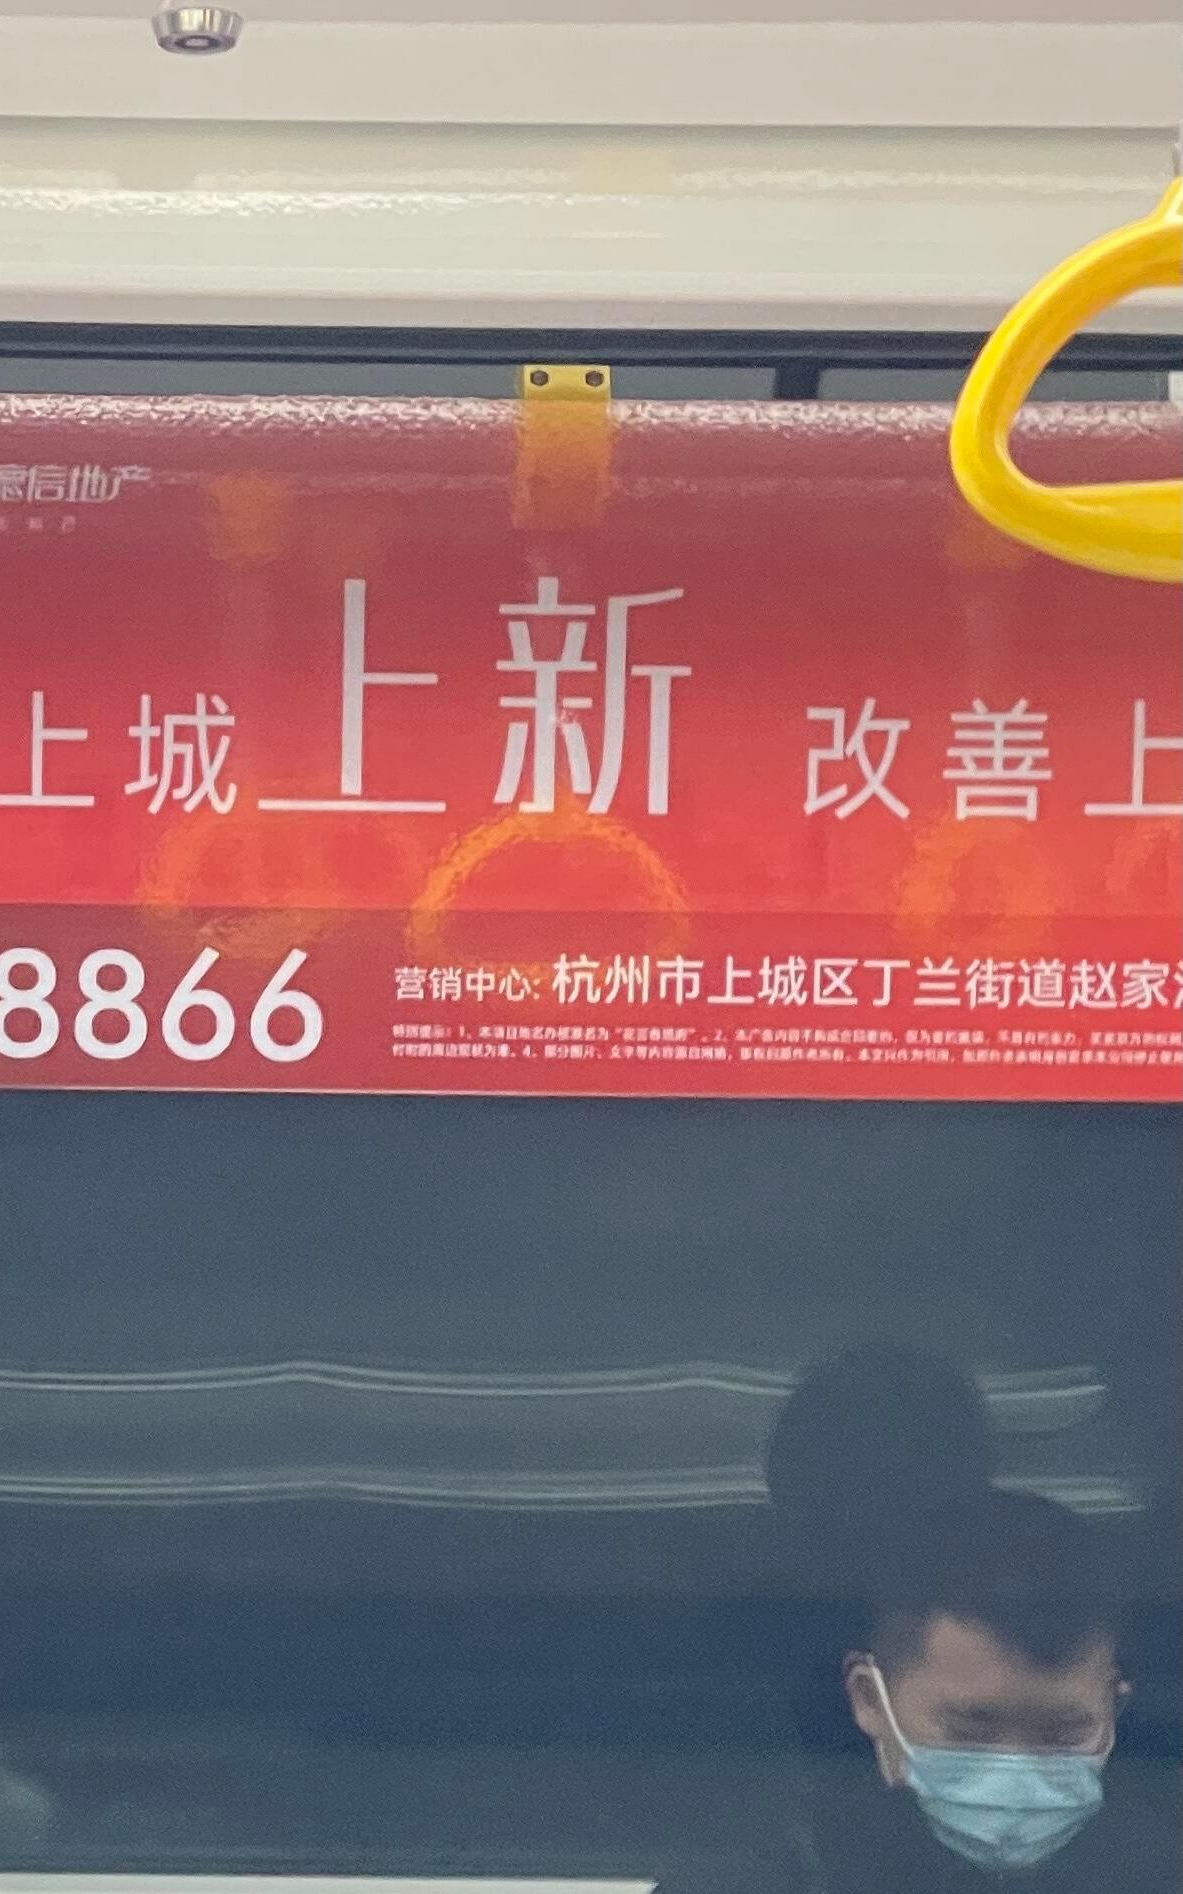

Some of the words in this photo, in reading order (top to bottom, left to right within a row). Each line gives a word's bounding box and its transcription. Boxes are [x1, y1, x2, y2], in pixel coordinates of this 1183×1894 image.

[551, 953, 1183, 1009] 杭州市上城区丁兰街道赵家
